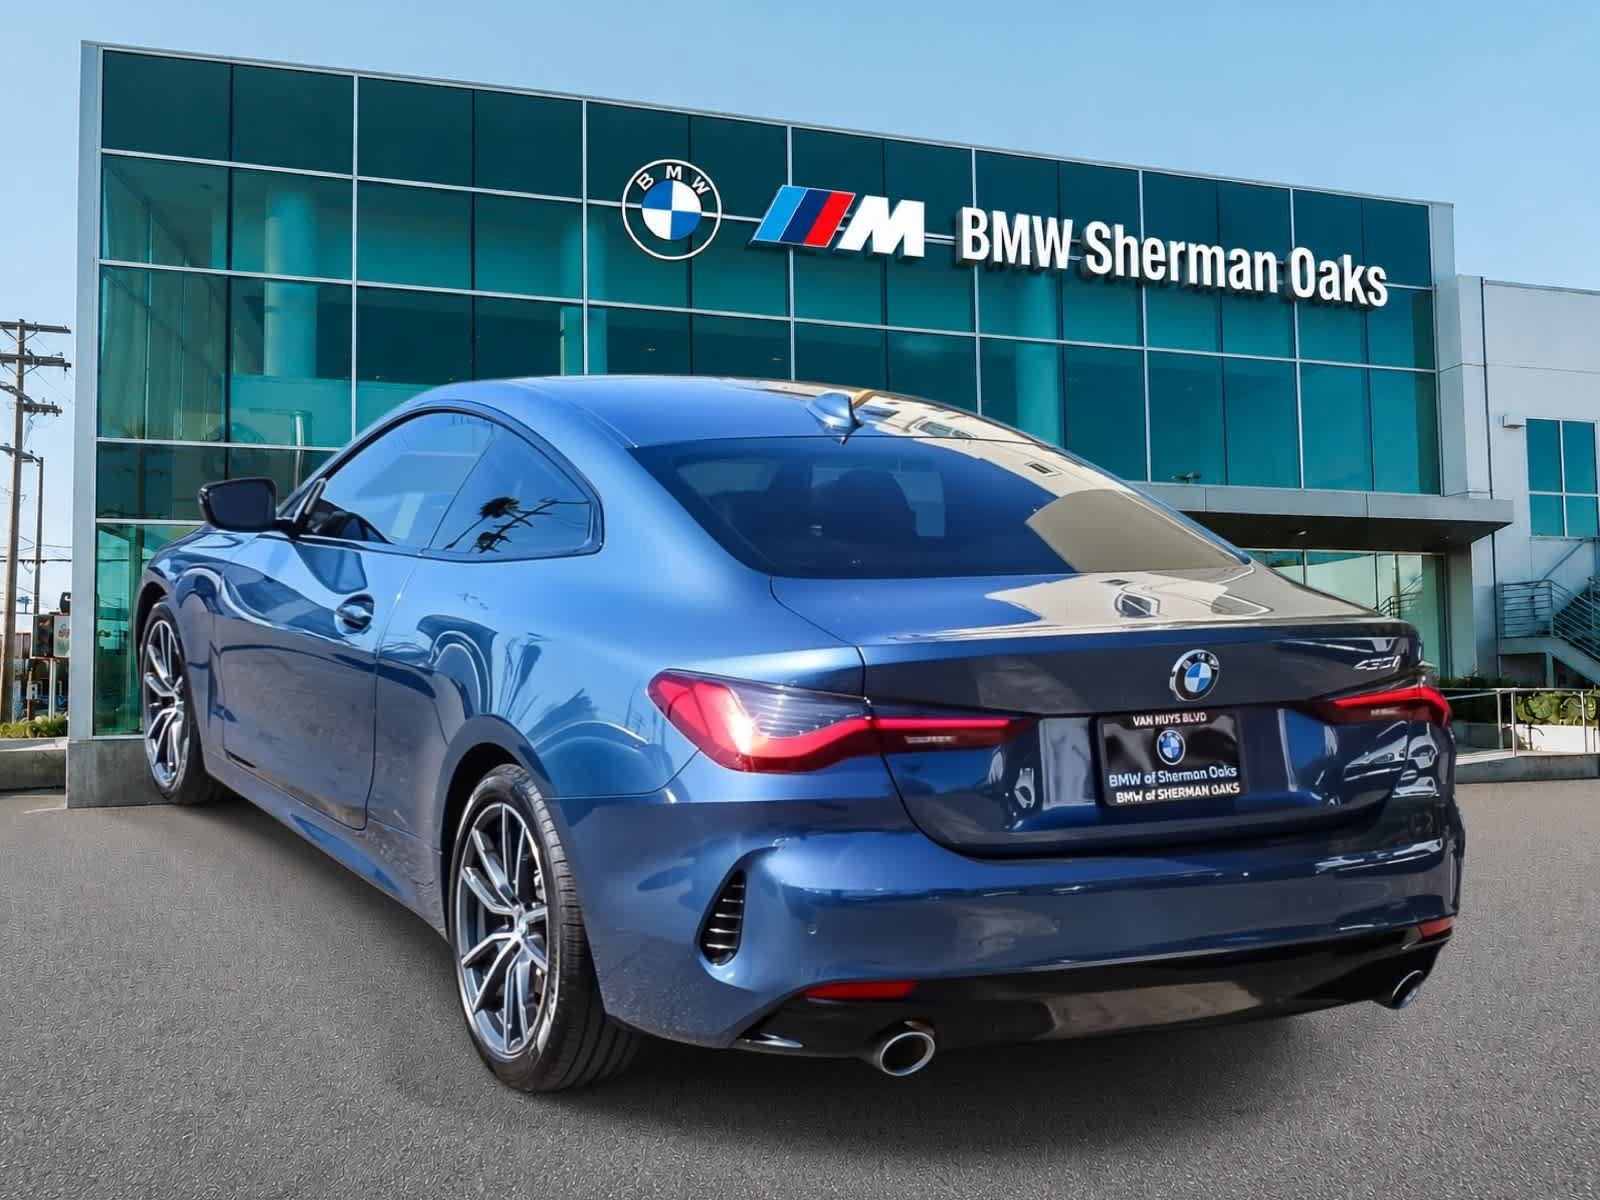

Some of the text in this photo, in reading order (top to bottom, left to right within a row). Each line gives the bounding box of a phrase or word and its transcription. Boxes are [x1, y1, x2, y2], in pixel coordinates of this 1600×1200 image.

[636, 165, 711, 195] BMW
[961, 206, 1388, 307] BMW Sherman Oaks
[1133, 711, 1207, 727] VAN NUYS BLVD
[1108, 765, 1237, 787] BMW of Sherman Oaks
[1116, 782, 1240, 803] BMW of SHERMAN OAKS
